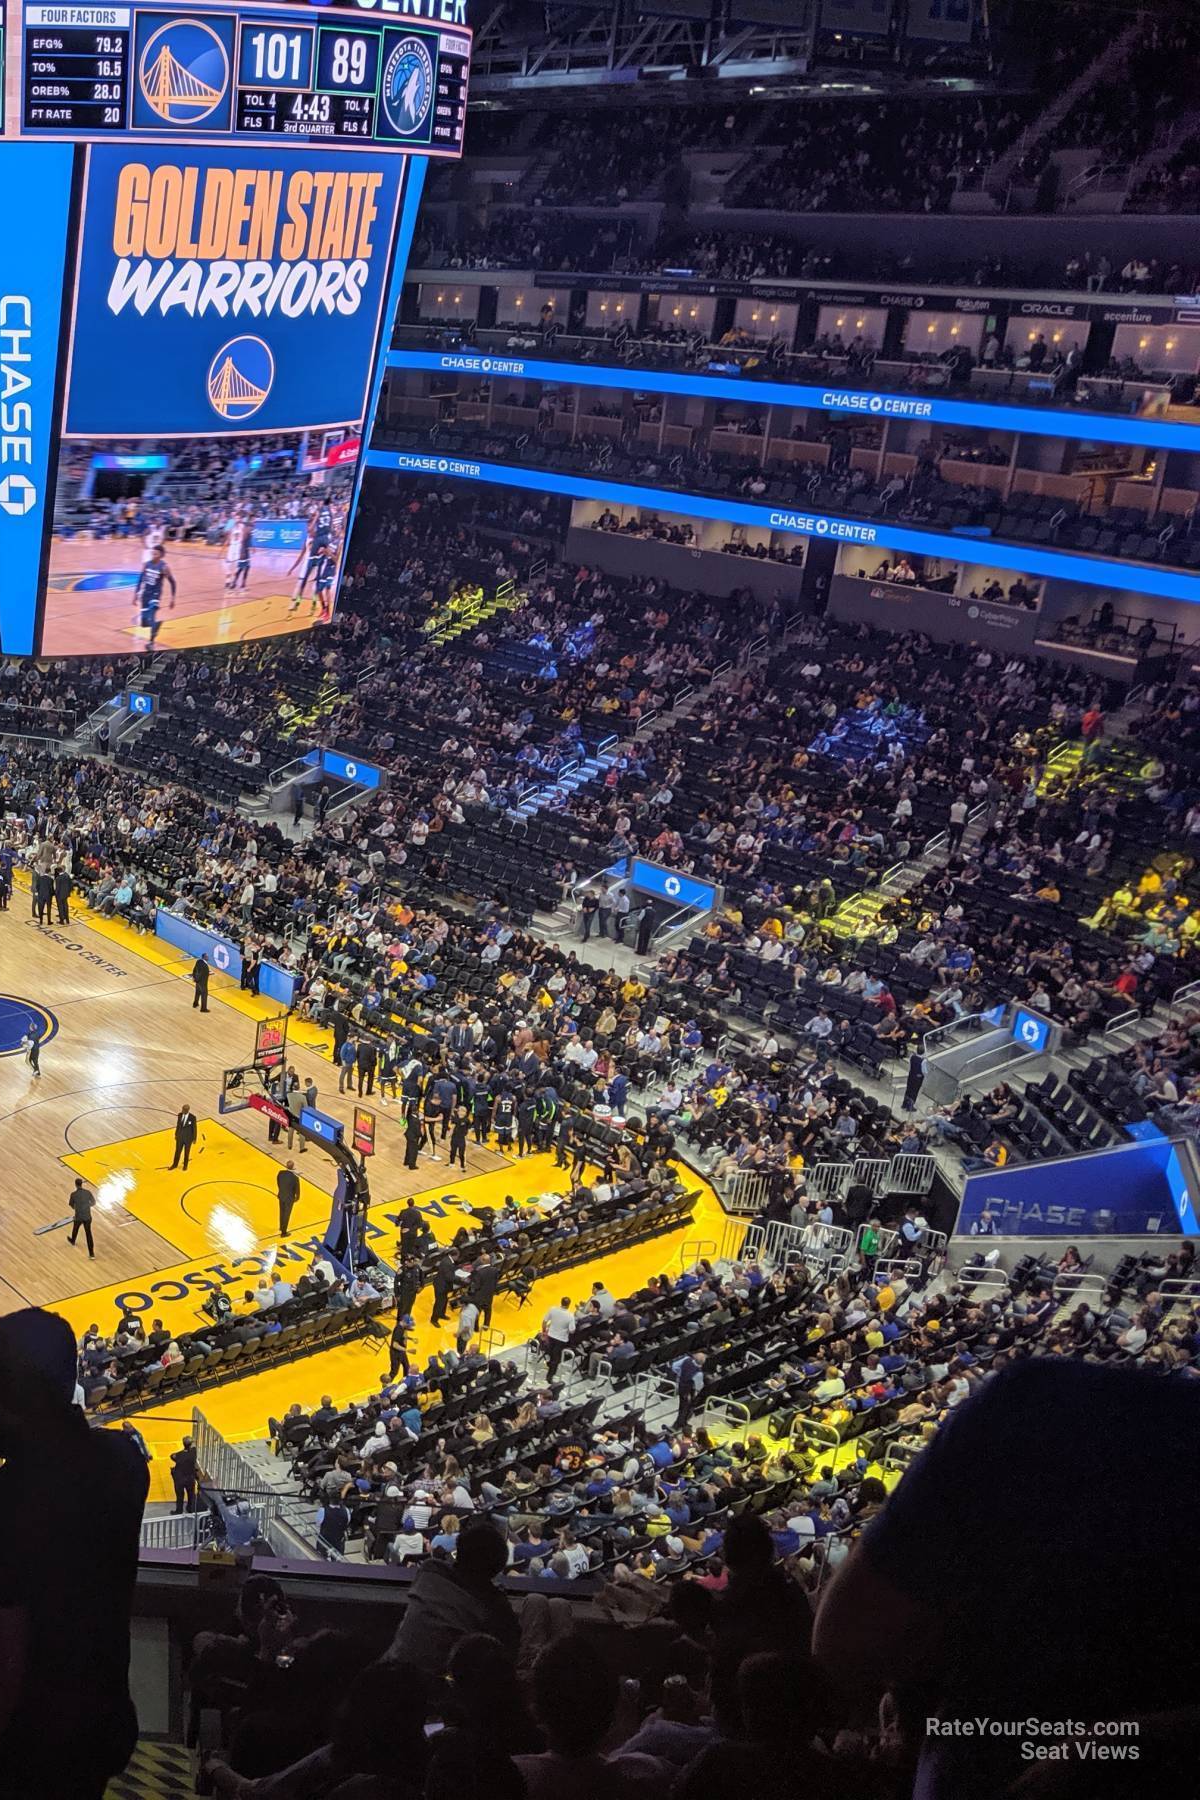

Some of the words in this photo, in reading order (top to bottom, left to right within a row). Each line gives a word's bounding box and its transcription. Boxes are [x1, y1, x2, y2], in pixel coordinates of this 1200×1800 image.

[41, 10, 67, 22] FOUR
[70, 10, 116, 24] FACTORS
[33, 40, 62, 50] EFG%
[96, 38, 122, 52] 79.2
[252, 32, 302, 80] 101
[332, 38, 366, 84] 89
[32, 63, 56, 72] TO%
[97, 61, 122, 76] 16.5
[32, 86, 70, 96] OREB%
[94, 84, 120, 100] 28.0
[246, 95, 264, 106] TOL
[269, 94, 276, 107] 4
[292, 95, 330, 121] 4:43
[345, 100, 360, 110] TOL
[363, 100, 370, 113] 4
[32, 110, 44, 118] FT
[46, 110, 72, 120] RATE
[104, 108, 120, 123] 20
[244, 117, 262, 128] FLS
[270, 116, 275, 130] 1
[284, 123, 298, 132] 3rd
[300, 124, 335, 134] QUARTER
[344, 122, 358, 132] FLS
[362, 121, 368, 134] 4
[113, 162, 284, 260] GOLDEN
[280, 170, 384, 260] STATE
[108, 258, 368, 319] WARRIORS
[880, 295, 913, 306] CHASE
[1021, 304, 1075, 315] ORACLE
[1104, 312, 1152, 322] accenture
[441, 357, 480, 370] CHASE
[492, 360, 524, 374] CENTER
[0, 295, 32, 465] CHASE
[822, 393, 868, 409] CHASE
[884, 399, 932, 416] CENTER
[399, 456, 437, 470] CHASE
[450, 462, 480, 476] CENTER
[770, 514, 815, 530] CHASE
[830, 522, 877, 541] CENTER
[24, 920, 73, 945] CHASE
[78, 948, 128, 978] CENTER
[502, 1104, 512, 1112] 12
[985, 1197, 1086, 1227] CHASE
[116, 1219, 390, 1313] FANCISCO
[574, 1560, 588, 1574] 30
